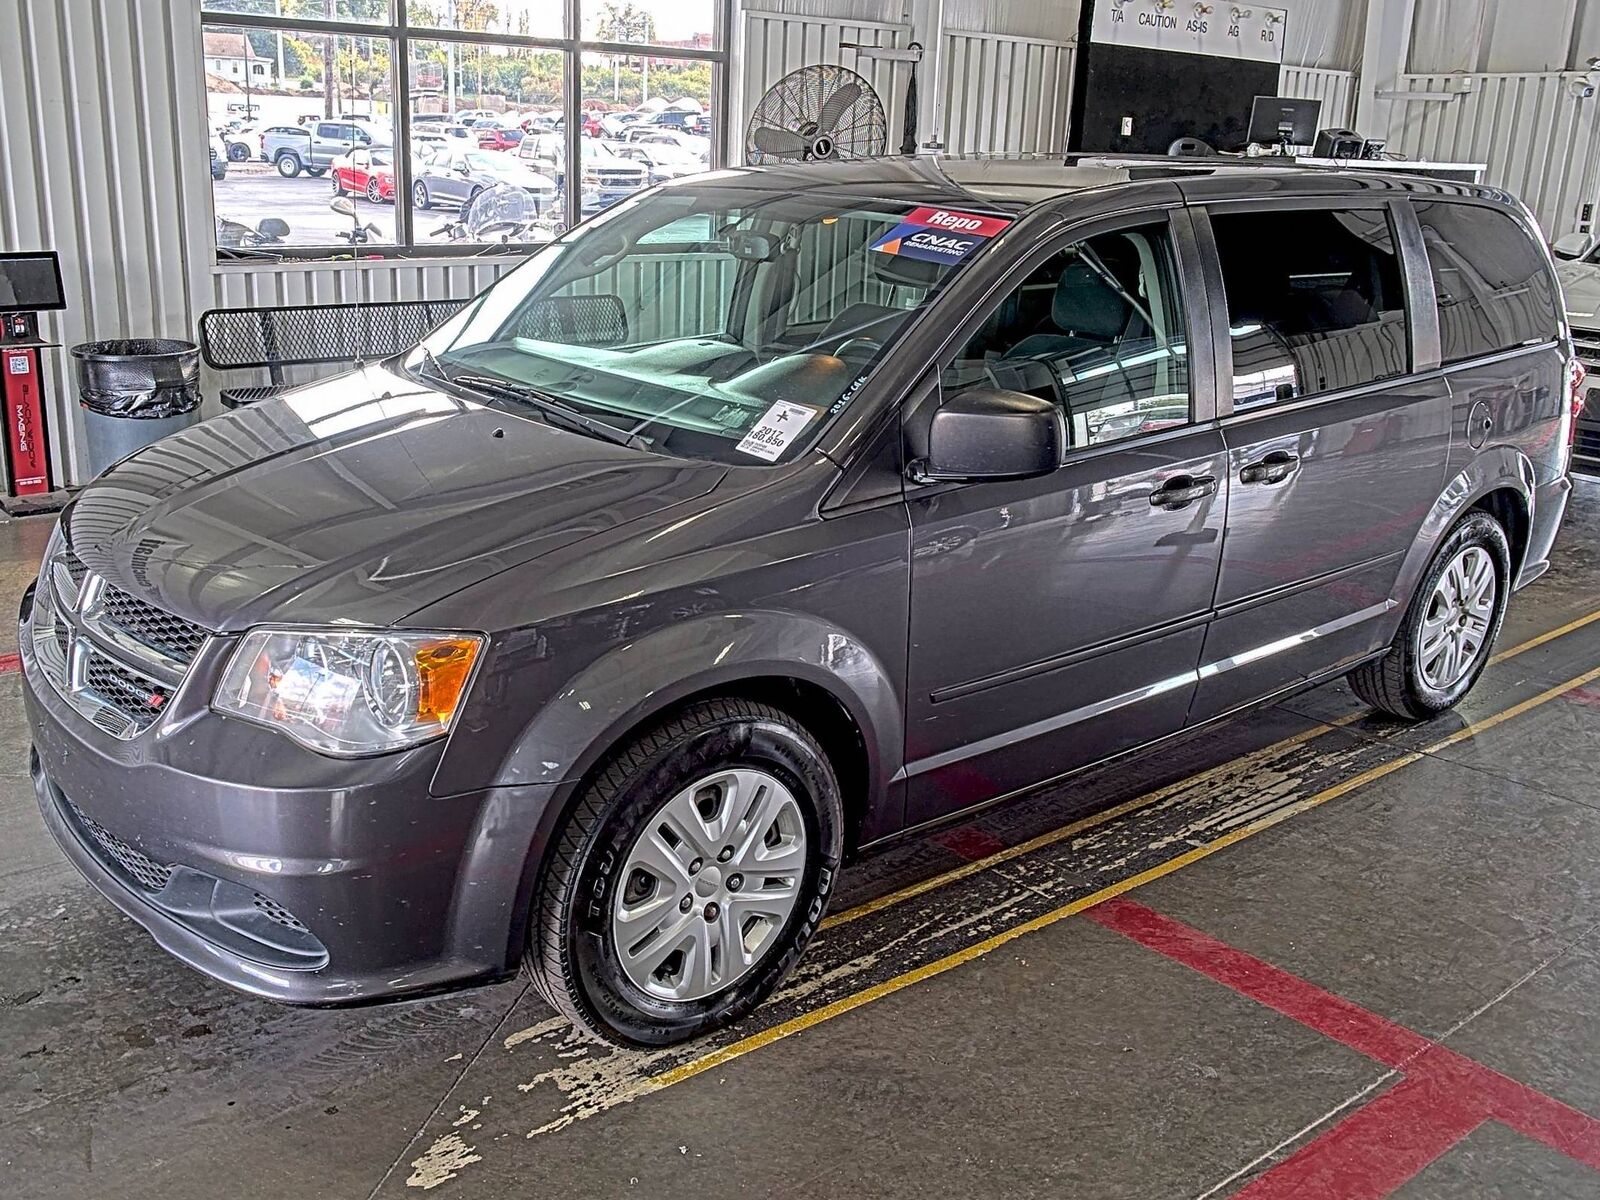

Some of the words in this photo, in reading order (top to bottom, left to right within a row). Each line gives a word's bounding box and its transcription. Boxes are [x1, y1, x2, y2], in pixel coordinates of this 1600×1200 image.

[1111, 9, 1124, 23] T/A
[1138, 12, 1177, 29] CAUTION
[1185, 20, 1208, 34] AS-IS
[1227, 25, 1239, 37] AG
[926, 210, 983, 230] Repo
[903, 240, 965, 257] REMARKETING
[22, 384, 32, 425] BLACK
[16, 404, 28, 451] IMAGING
[758, 426, 784, 438] 2017
[747, 430, 785, 447] 180,850
[109, 674, 152, 701] DODGE
